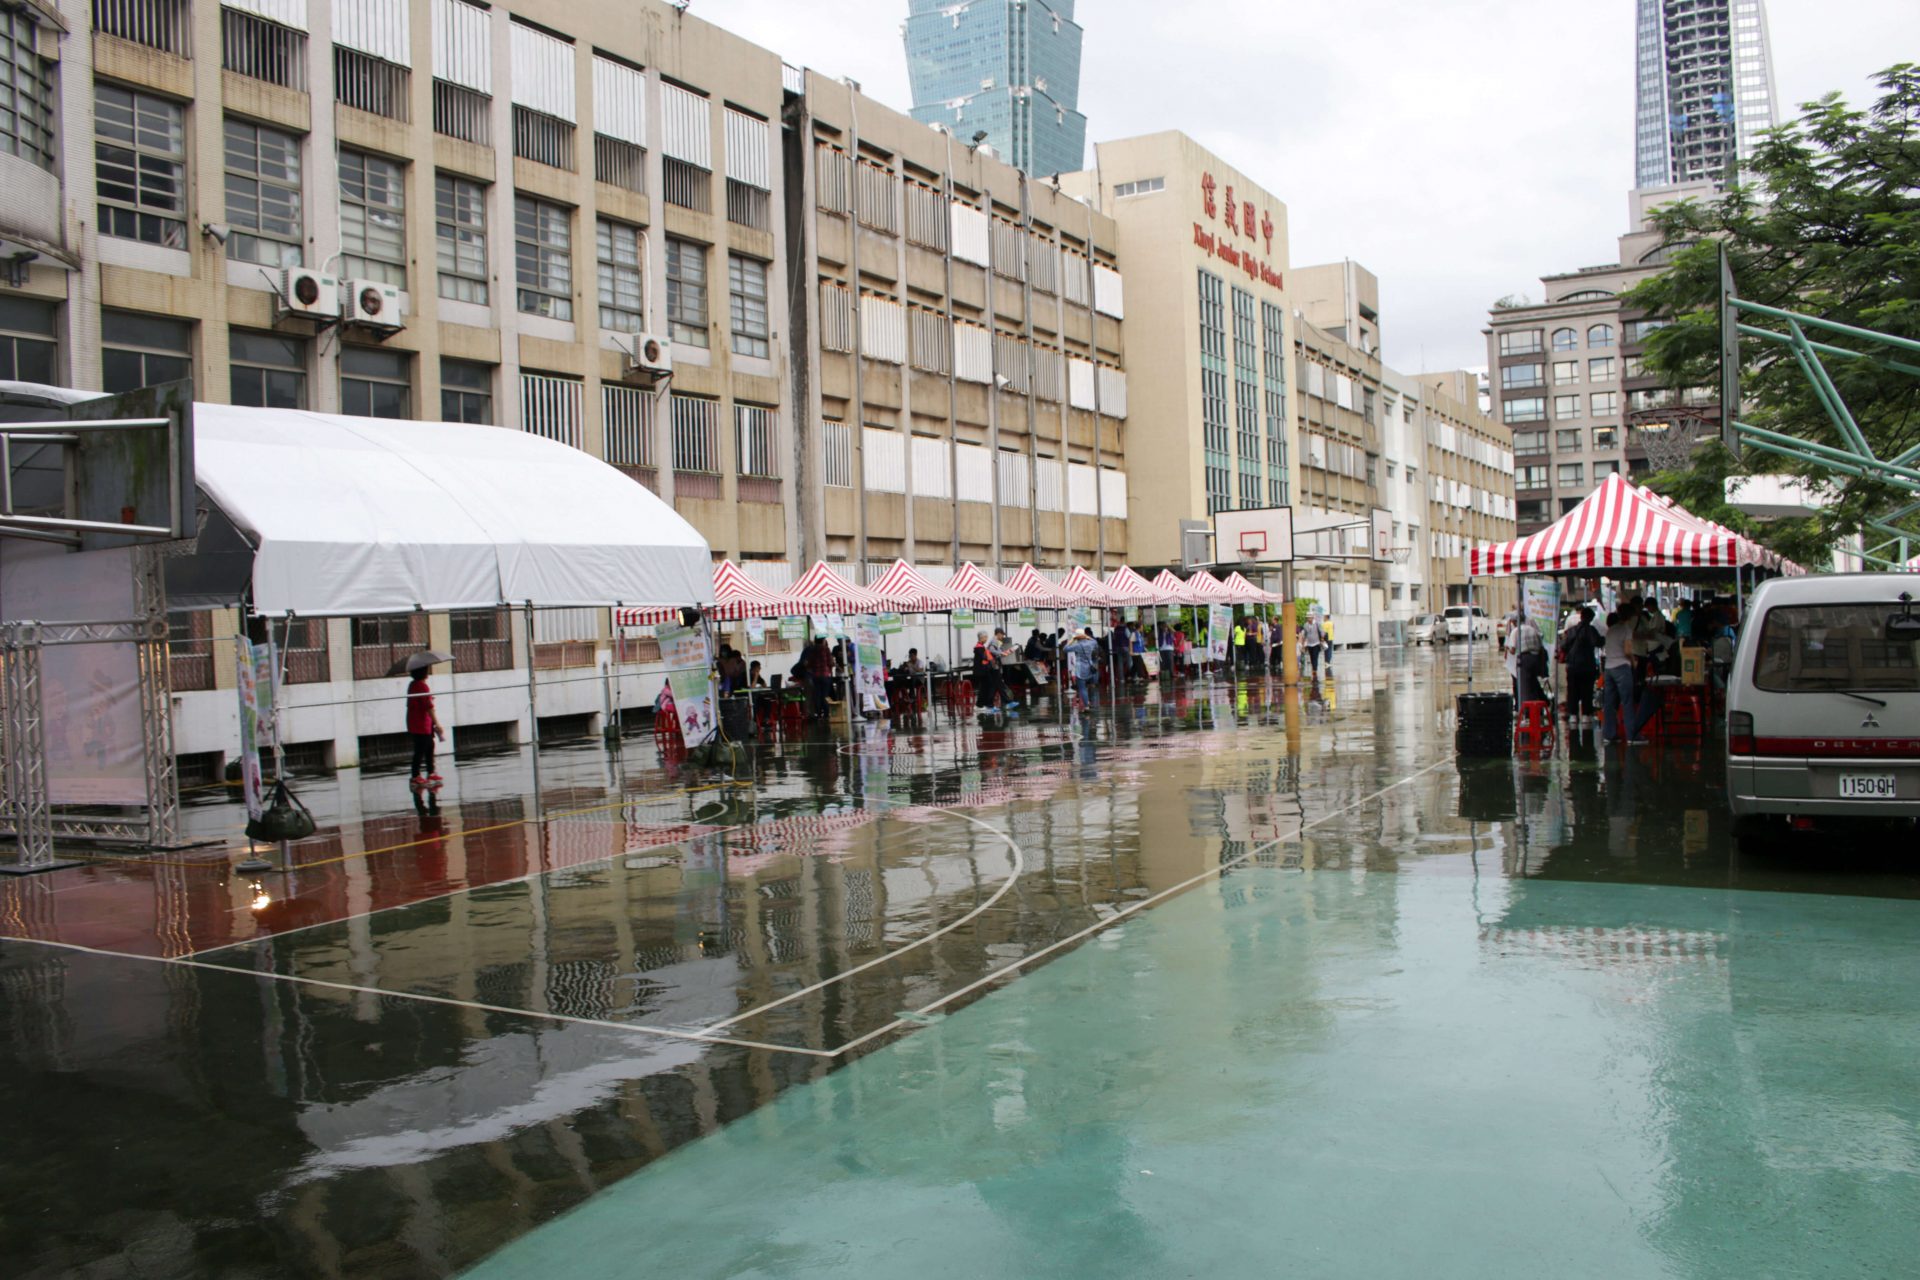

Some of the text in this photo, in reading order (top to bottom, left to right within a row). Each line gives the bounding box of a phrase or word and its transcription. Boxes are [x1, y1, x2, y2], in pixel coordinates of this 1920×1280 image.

[1202, 171, 1274, 255] 信義國中
[1217, 236, 1240, 267] Junior
[1242, 250, 1258, 281] High
[1260, 260, 1283, 291] School
[1813, 740, 1920, 748] DELICA
